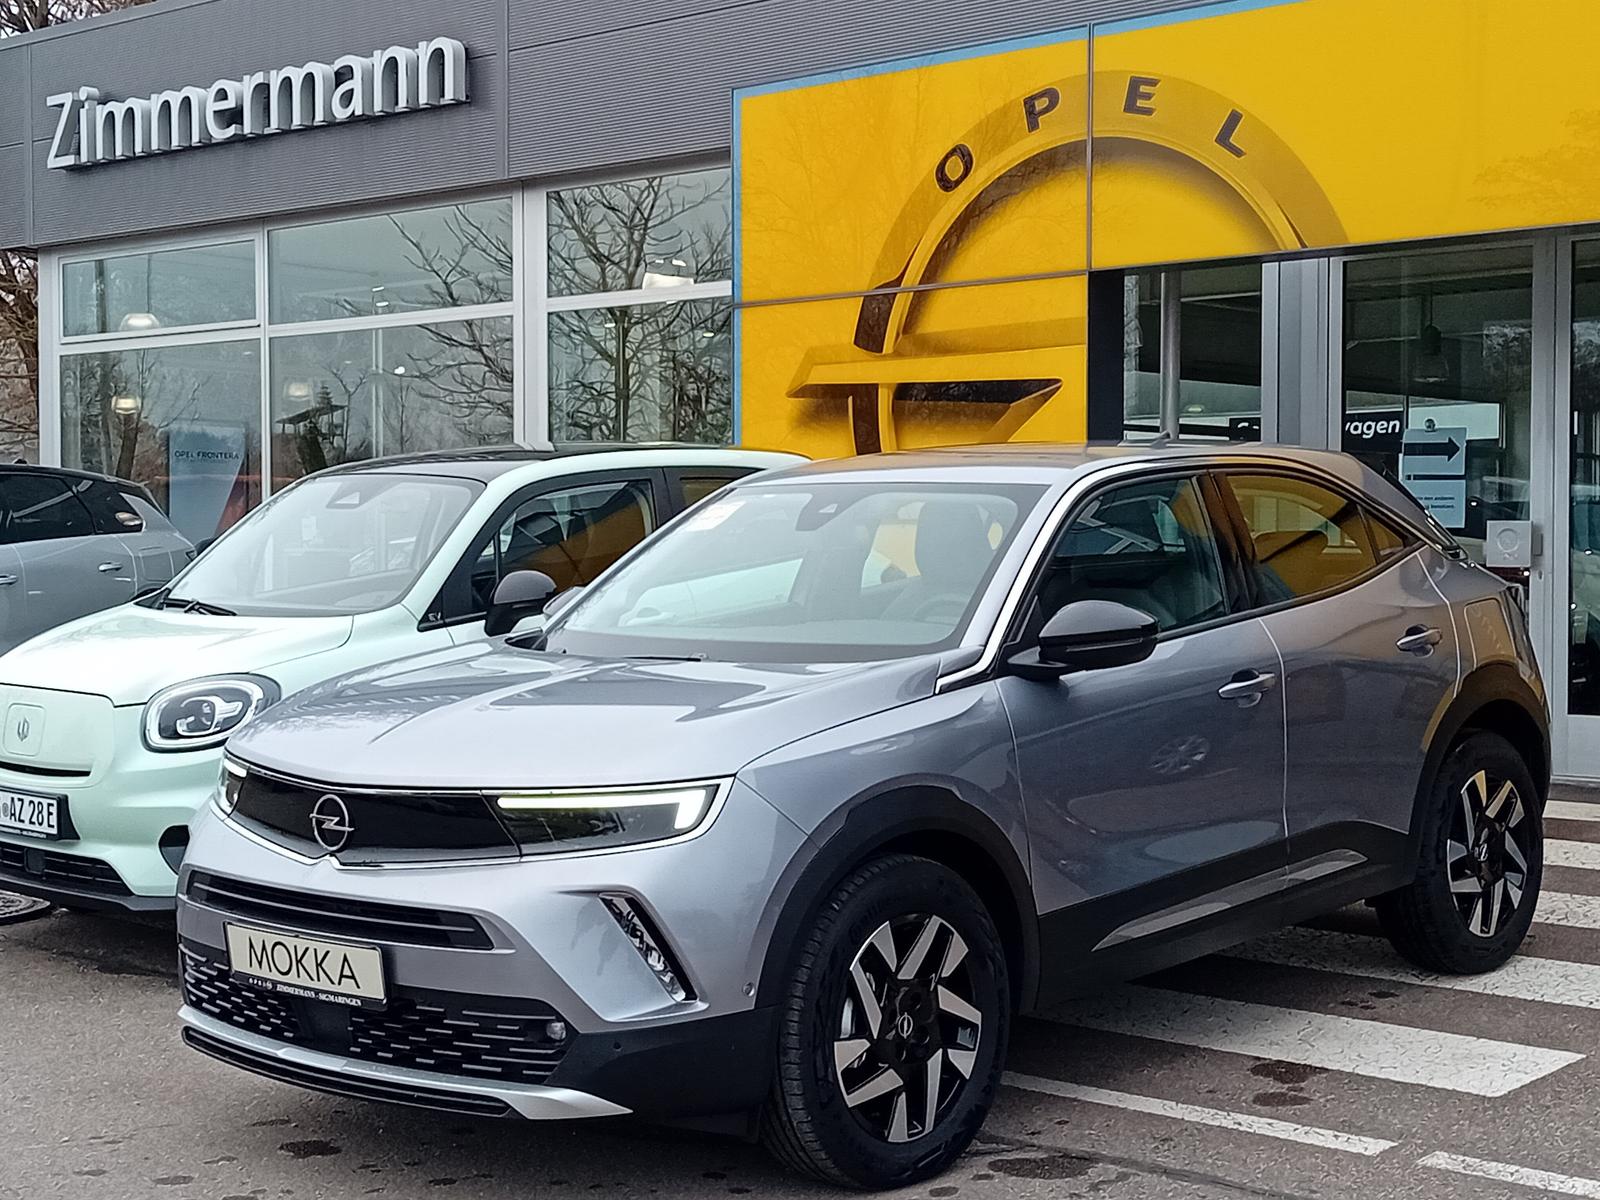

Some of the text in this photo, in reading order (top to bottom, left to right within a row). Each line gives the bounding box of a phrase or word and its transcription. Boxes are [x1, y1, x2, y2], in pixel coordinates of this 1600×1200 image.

[46, 36, 469, 170] Zimmermann
[935, 75, 1247, 193] OPEL
[1345, 419, 1400, 439] agen
[174, 450, 240, 460] OPEL FRONTERA
[9, 796, 26, 824] AZ
[248, 935, 361, 990] MOKKA
